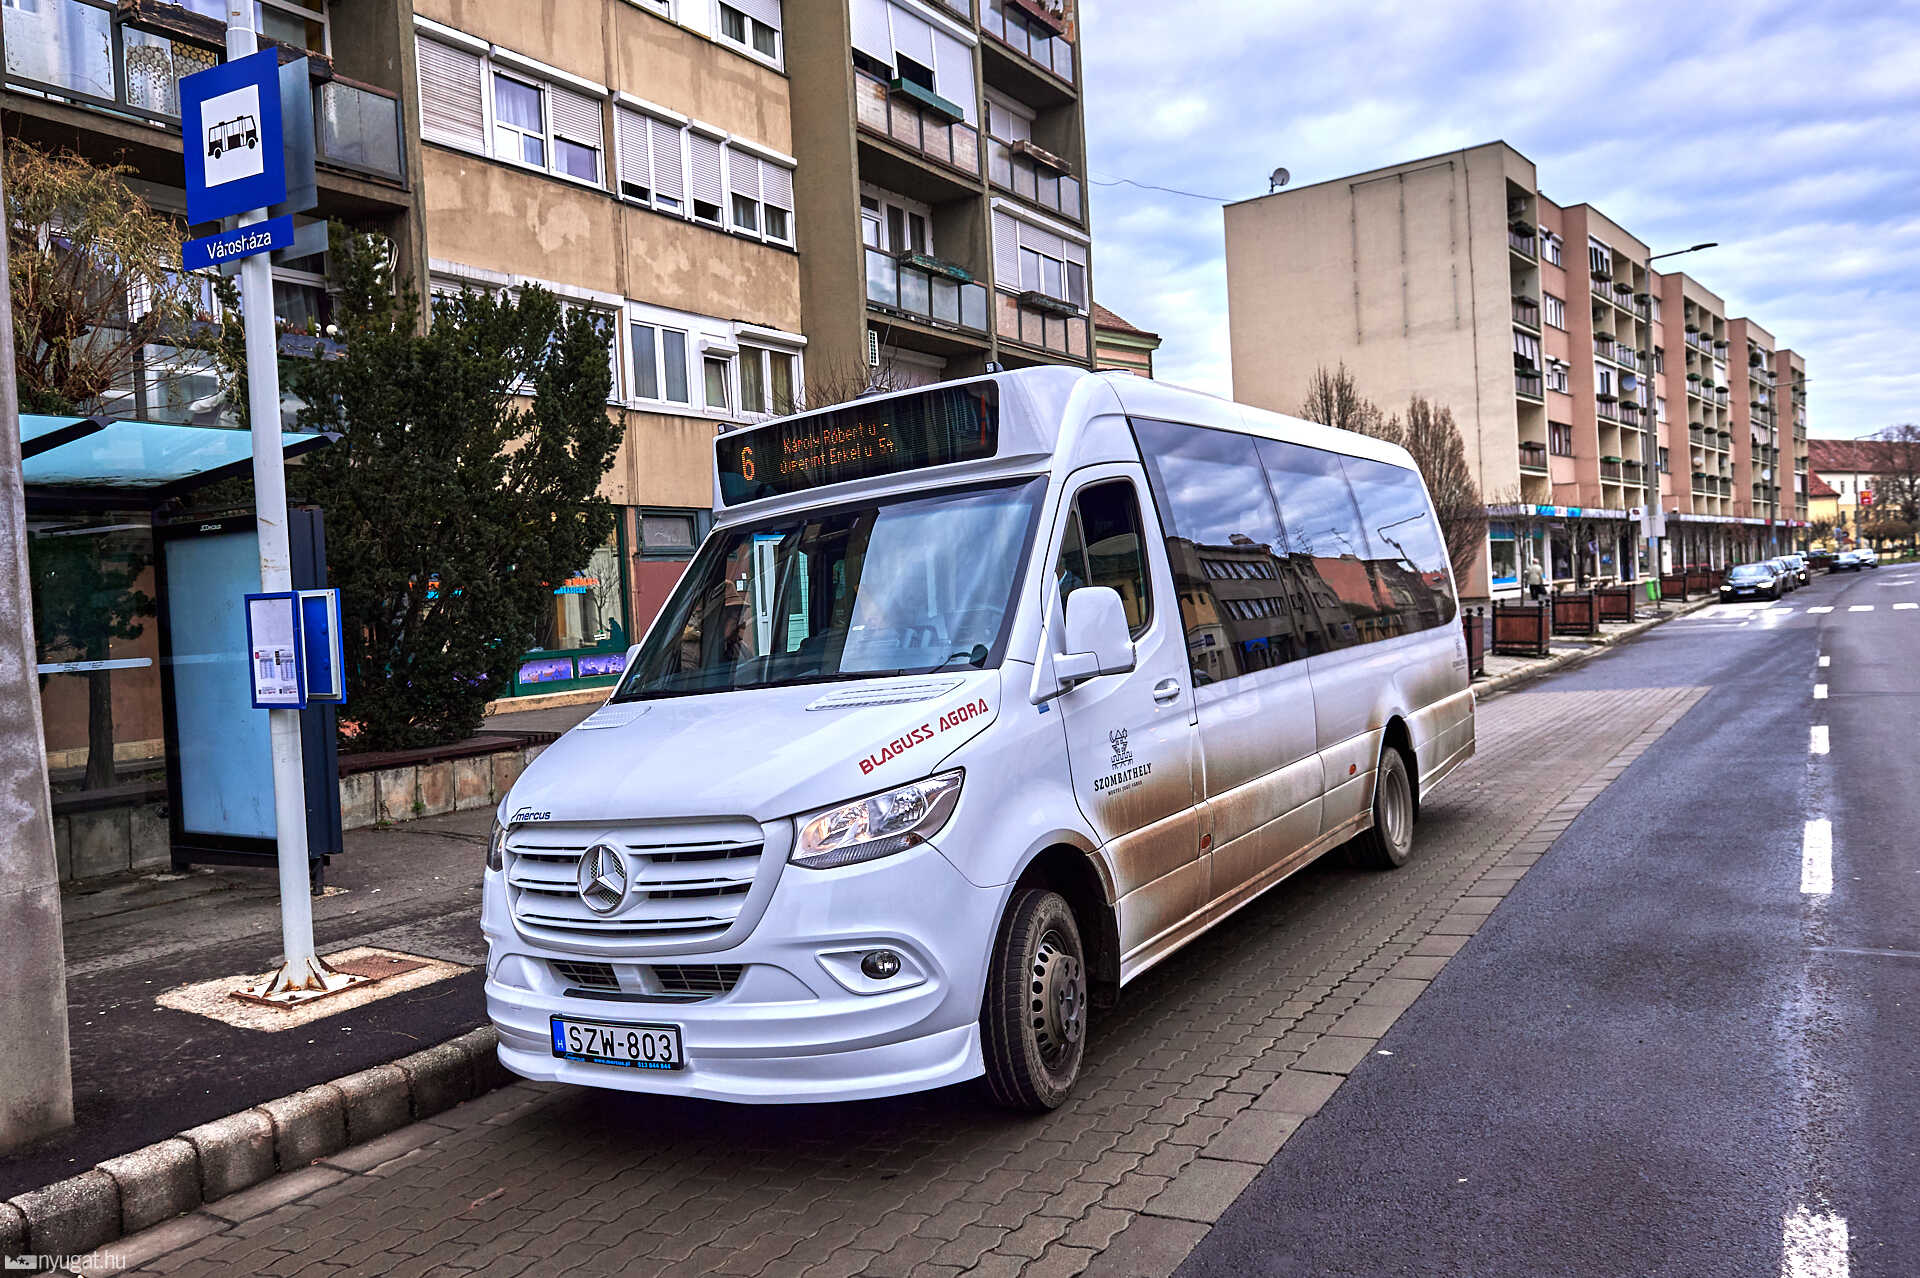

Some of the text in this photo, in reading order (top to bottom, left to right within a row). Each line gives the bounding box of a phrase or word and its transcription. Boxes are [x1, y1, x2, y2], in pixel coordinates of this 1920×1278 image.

[206, 231, 272, 260] Városháza
[741, 446, 755, 481] 6
[829, 443, 861, 466] Erkel
[858, 698, 989, 775] BLAGUSS AGORA
[1094, 762, 1152, 792] SZOMBATHELY
[513, 809, 551, 821] mercus
[557, 1040, 564, 1049] H
[569, 1026, 673, 1062] SZW-803
